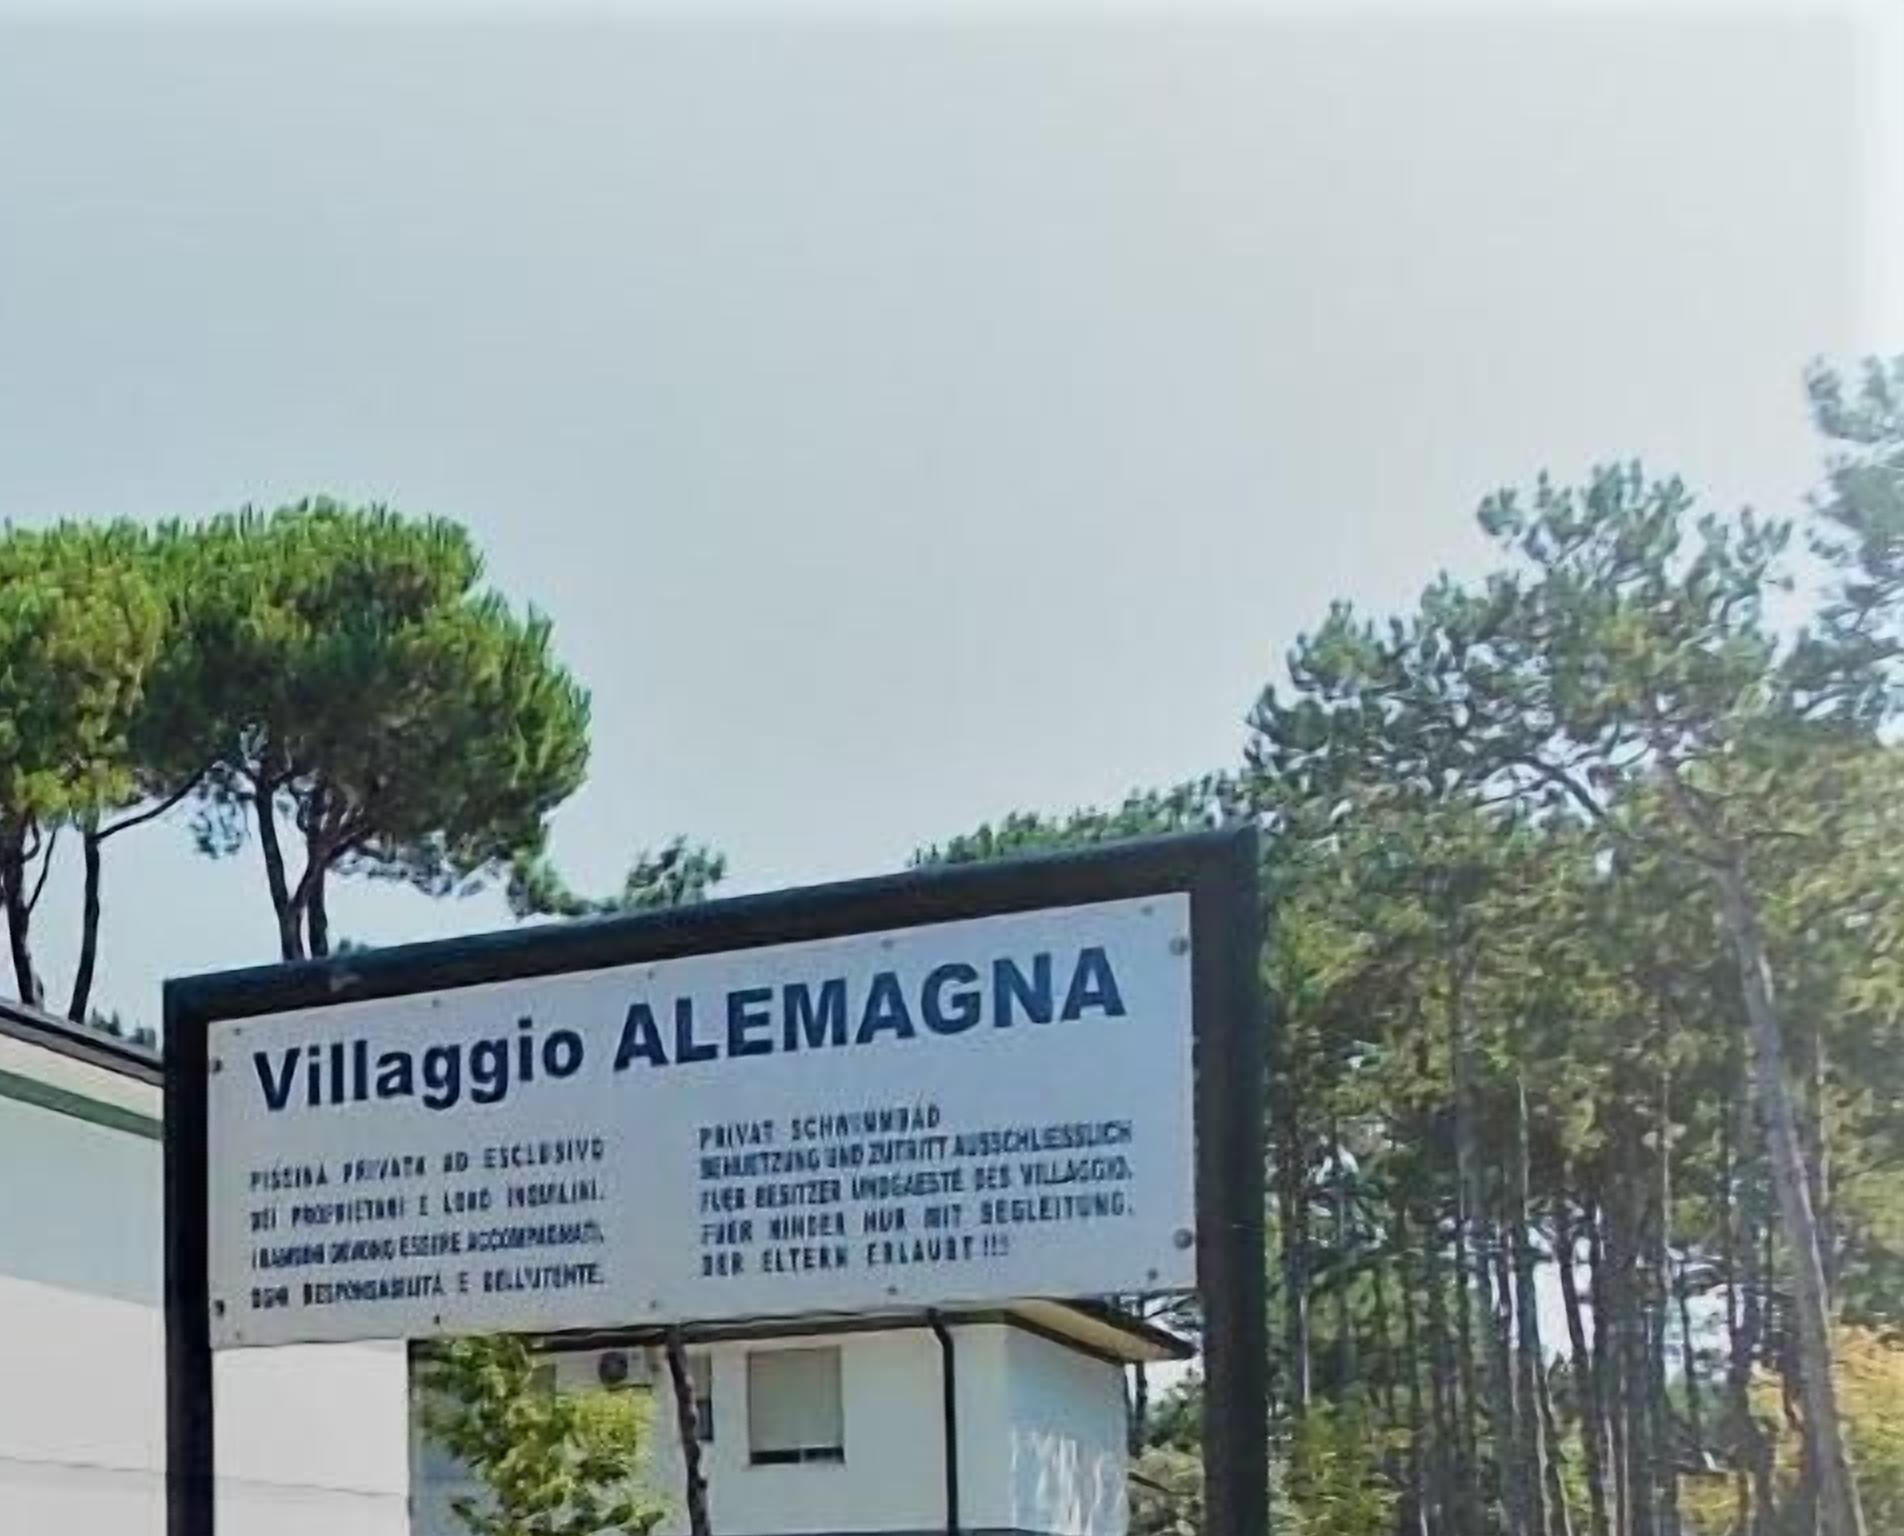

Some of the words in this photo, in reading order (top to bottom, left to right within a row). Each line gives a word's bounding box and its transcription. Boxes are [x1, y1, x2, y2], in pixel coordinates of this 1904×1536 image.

[253, 1017, 585, 1113] Villaggio
[613, 946, 1128, 1072] ALEMAGNA
[699, 1120, 773, 1150] PRIVAT
